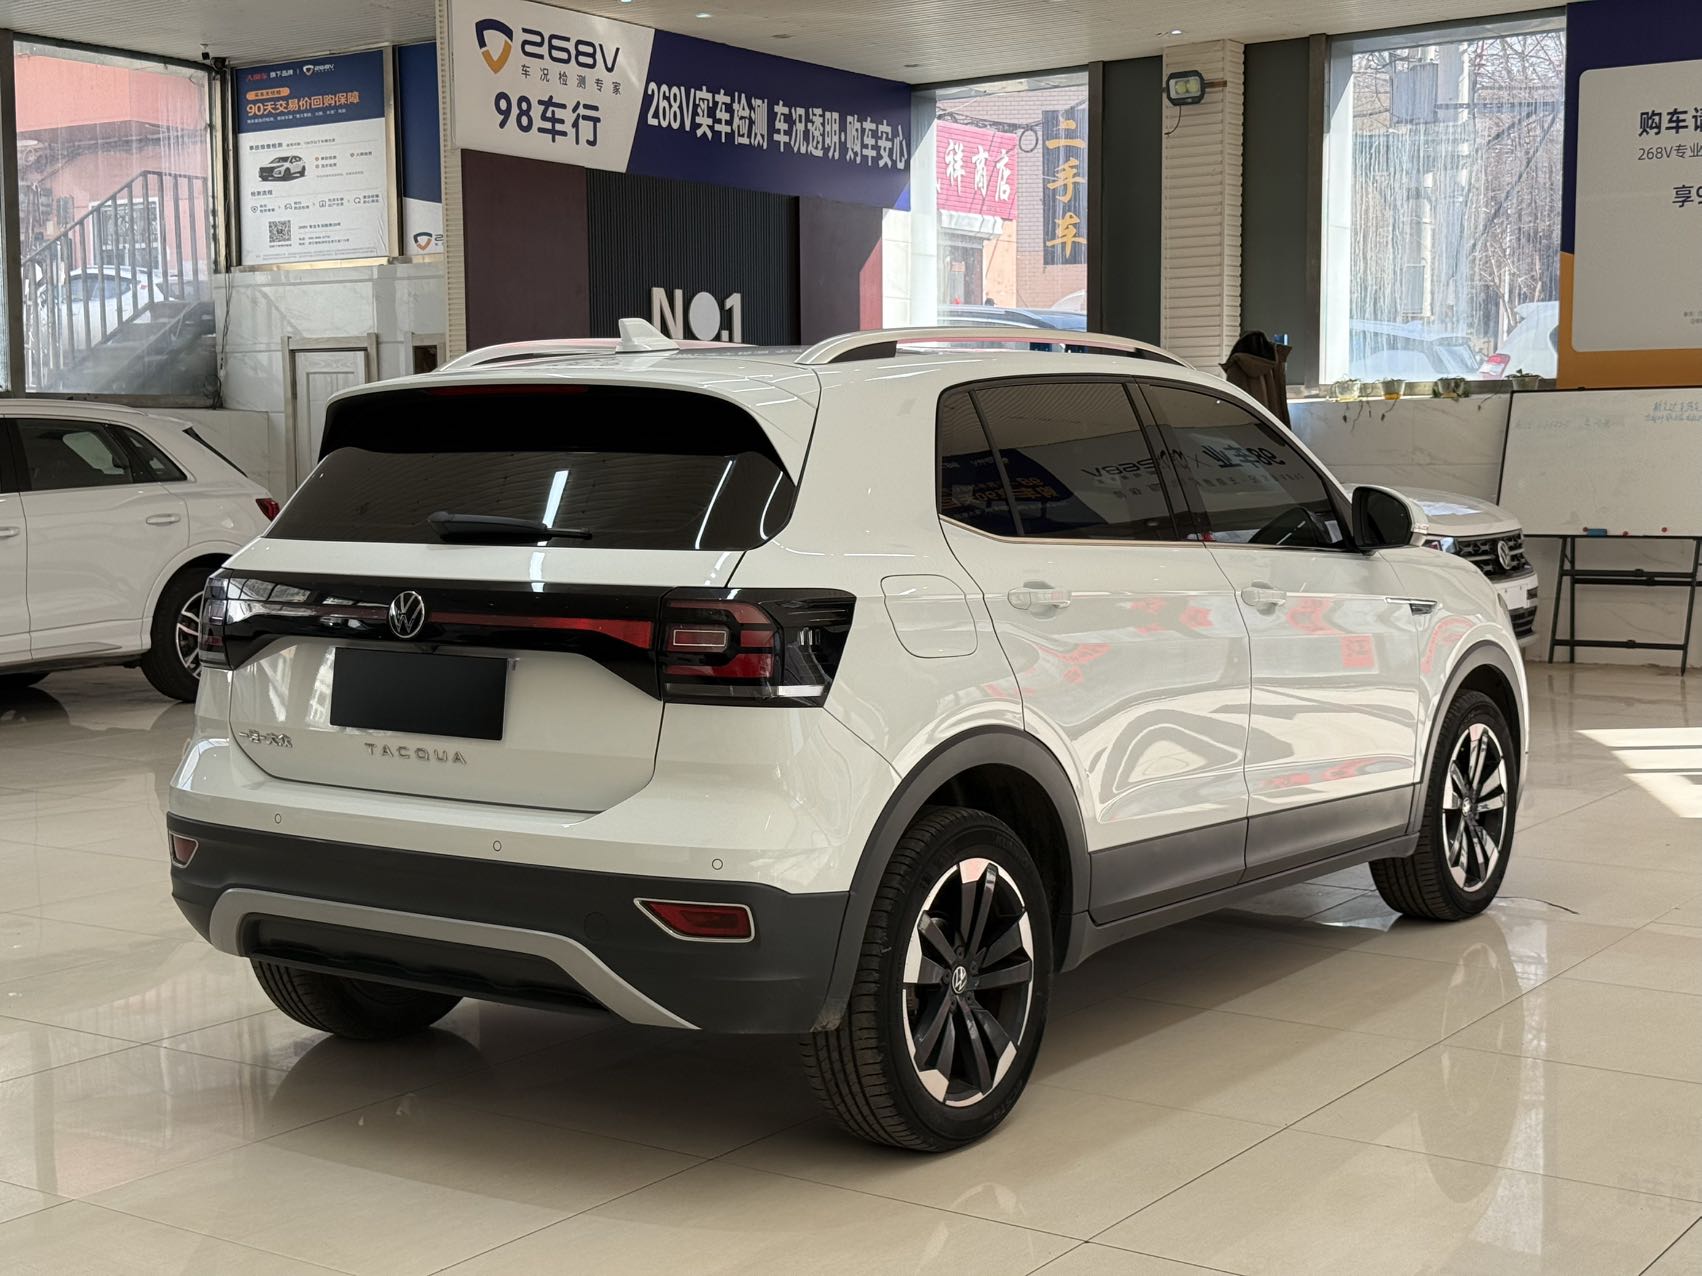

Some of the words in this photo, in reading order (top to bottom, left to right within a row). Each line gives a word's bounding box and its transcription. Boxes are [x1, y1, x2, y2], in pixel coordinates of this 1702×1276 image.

[520, 27, 621, 74] 268V
[246, 91, 360, 117] 90天交易价回购保障
[520, 64, 623, 95] 车况检测专家
[494, 91, 602, 147] 98车行
[647, 81, 768, 150] 268V实车检测
[1046, 118, 1088, 259] 二手车
[651, 287, 742, 343] NO.1
[364, 742, 468, 765] TACQUA
